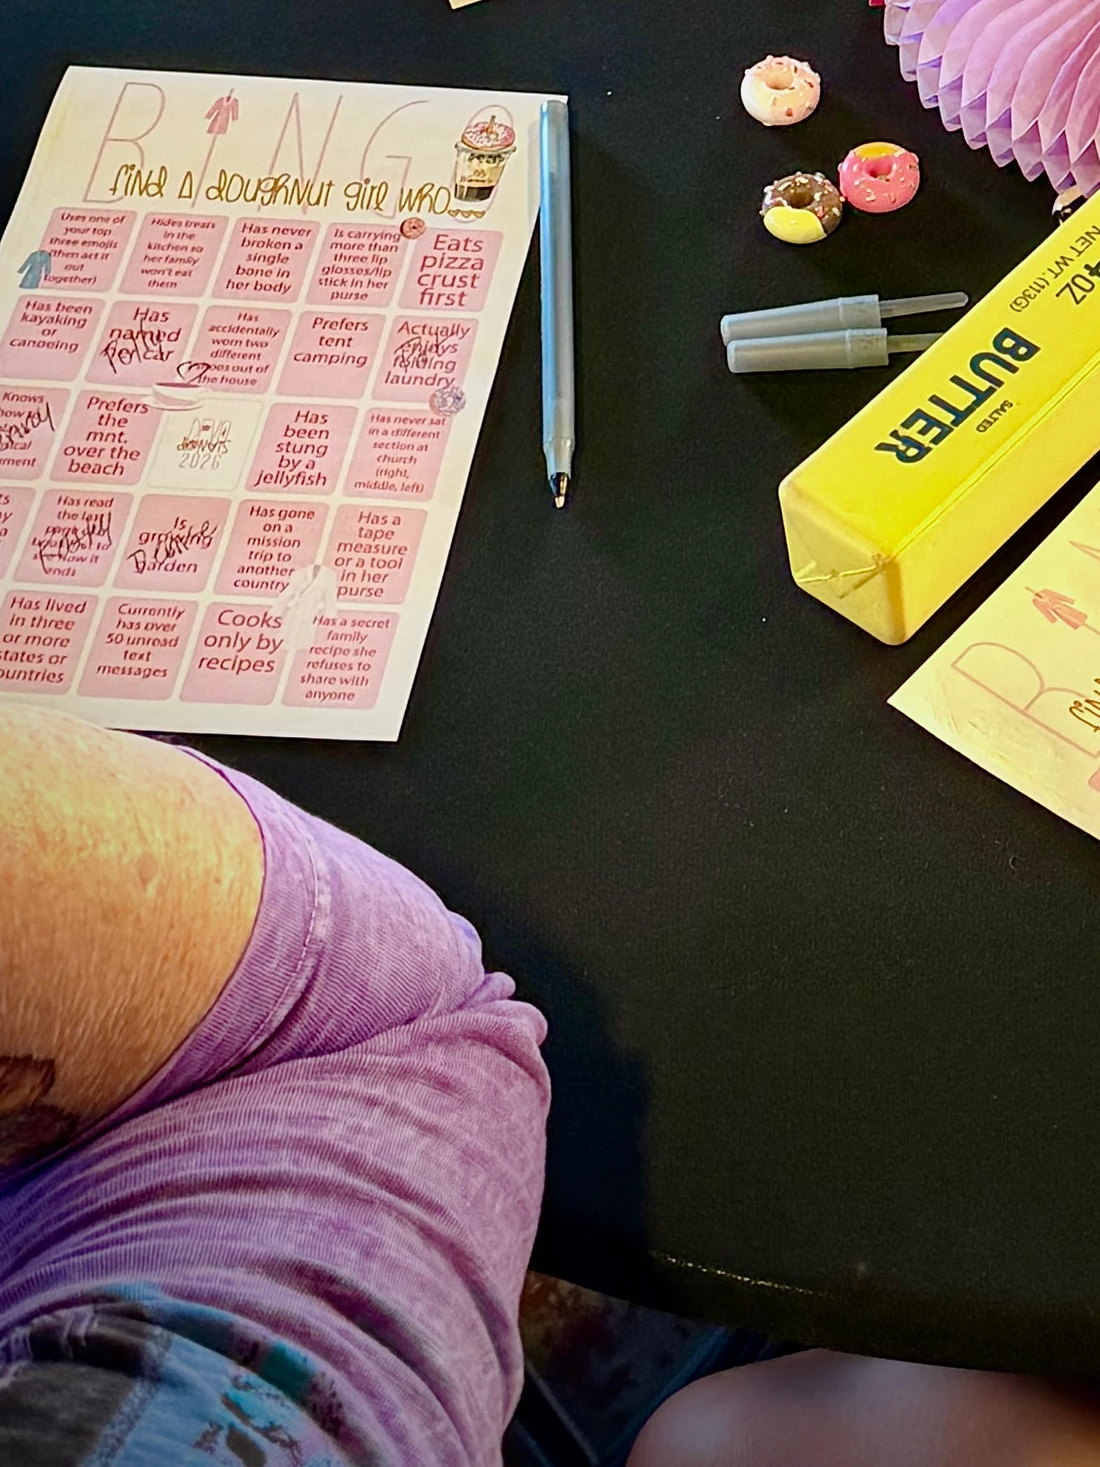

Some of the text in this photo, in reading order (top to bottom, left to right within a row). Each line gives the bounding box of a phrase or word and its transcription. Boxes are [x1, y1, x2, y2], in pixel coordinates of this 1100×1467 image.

[241, 222, 311, 237] Has never
[240, 236, 291, 249] broken
[432, 233, 483, 252] Eats
[246, 252, 289, 265] single
[419, 252, 483, 272] pizza
[235, 264, 290, 278] bone in
[225, 278, 291, 294] her body
[417, 273, 479, 289] crust
[1055, 274, 1095, 305] OZ
[419, 286, 466, 306] first
[1009, 277, 1050, 312] (113G)
[311, 316, 368, 331] Prefers
[318, 335, 352, 347] tent
[293, 352, 367, 367] camping
[874, 327, 1041, 464] BUTTER
[86, 396, 150, 413] Prefers
[97, 412, 128, 427] the
[294, 410, 327, 424] Has
[976, 400, 1013, 433] SALTED
[283, 424, 329, 439] been
[63, 445, 140, 460] over the
[275, 441, 328, 458] stung
[67, 458, 124, 475] beach
[177, 452, 223, 470] 2026
[277, 454, 315, 472] by a
[253, 470, 326, 488] jellyfish
[217, 609, 282, 628] Cooks
[203, 631, 283, 654] only by
[197, 654, 274, 675] recipes
